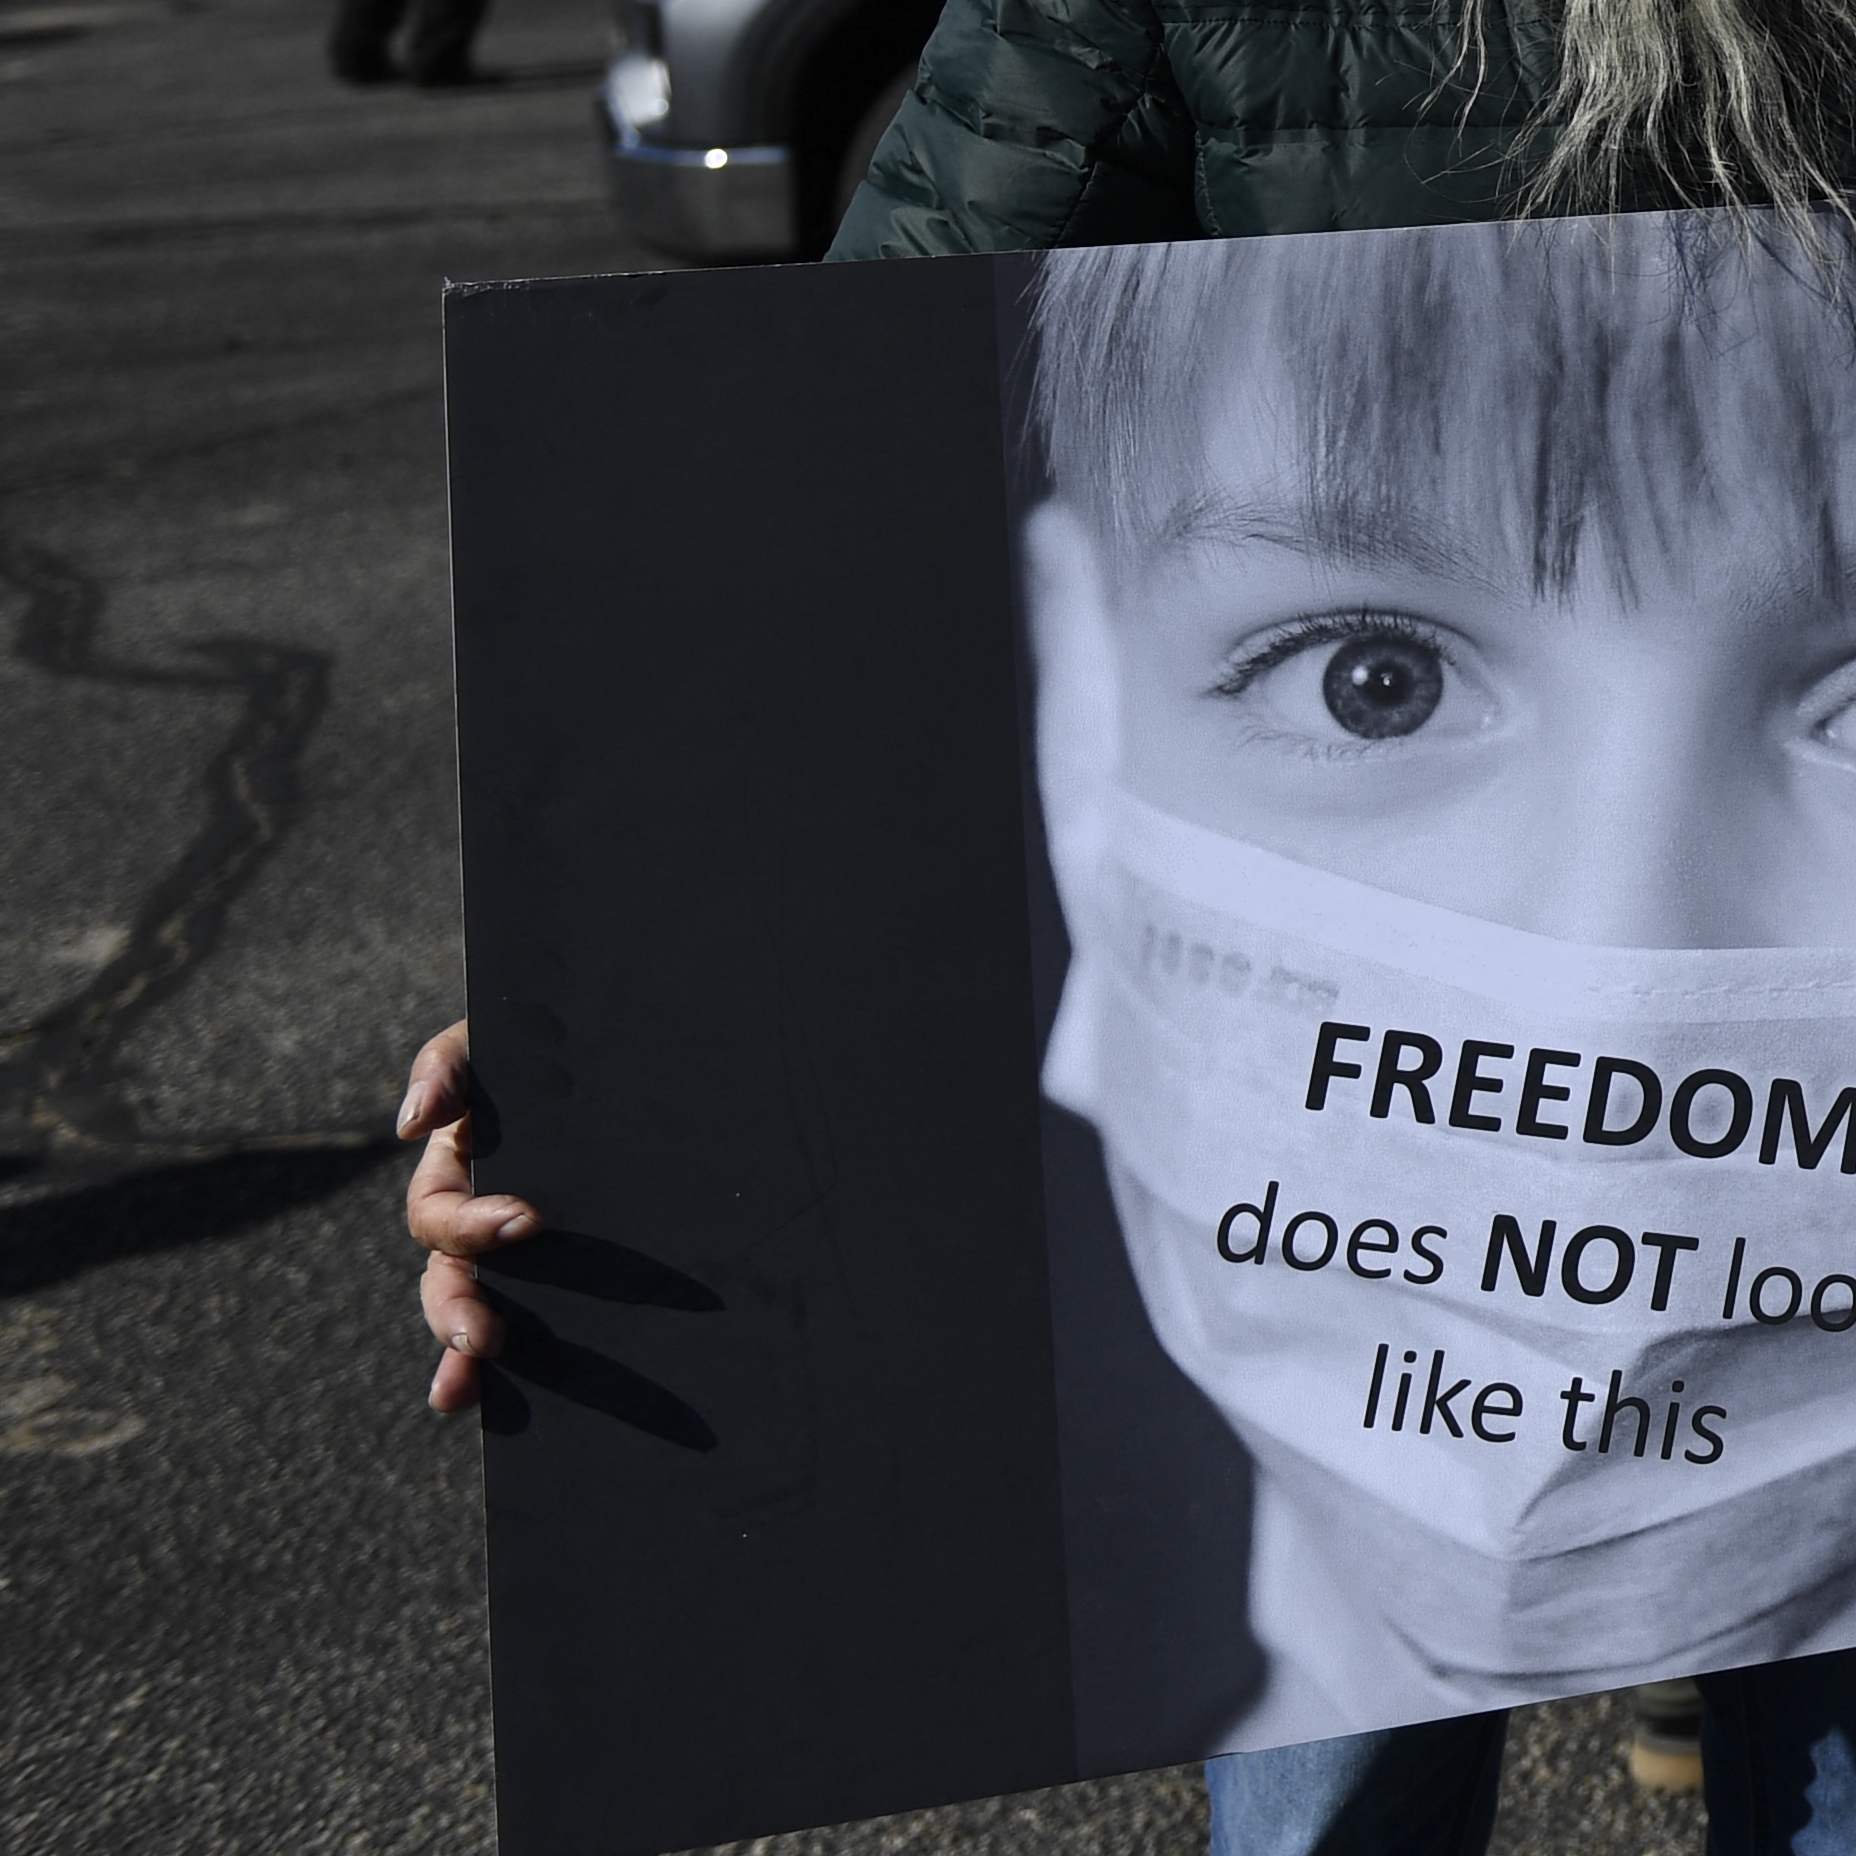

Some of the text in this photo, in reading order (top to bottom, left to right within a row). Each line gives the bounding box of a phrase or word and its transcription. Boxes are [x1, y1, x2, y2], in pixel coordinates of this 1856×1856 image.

[1215, 1180, 1450, 1285] does
[1480, 1212, 1700, 1312] NOT
[1362, 1342, 1729, 1466] like this
